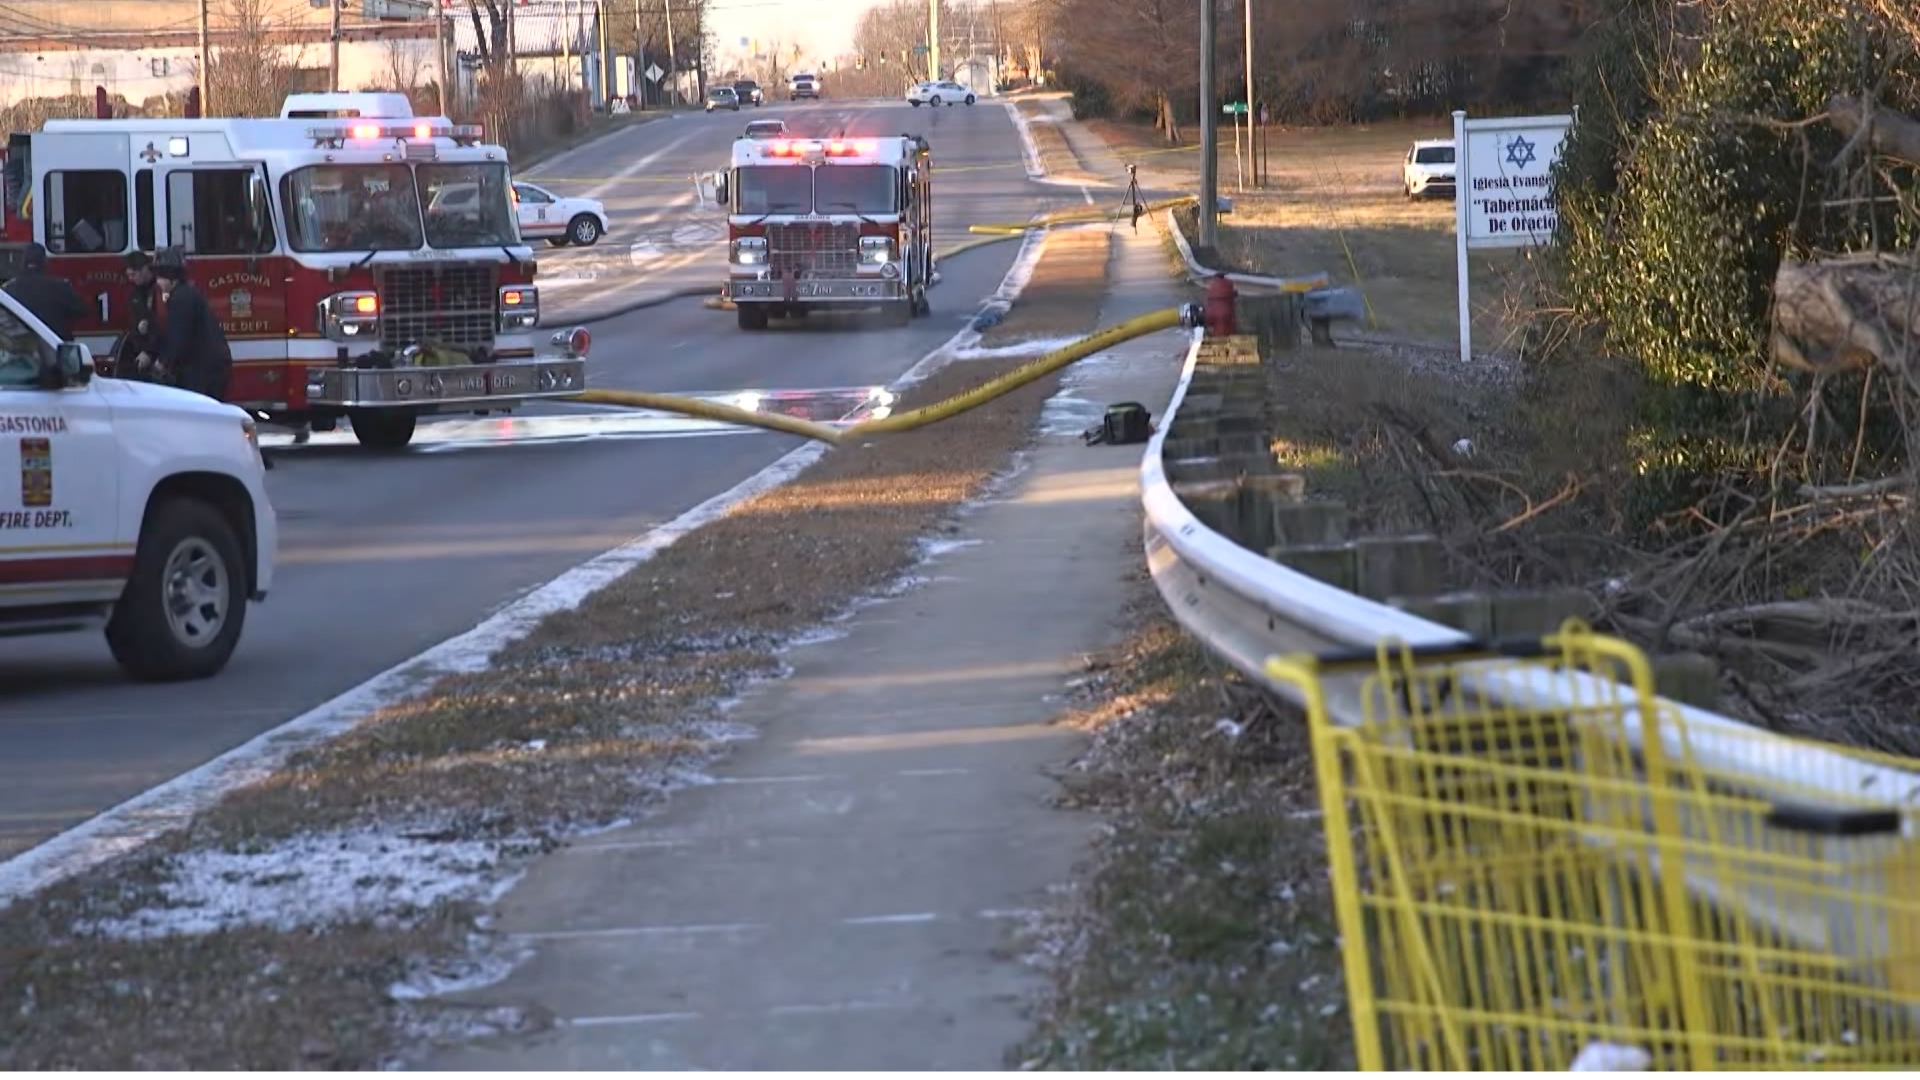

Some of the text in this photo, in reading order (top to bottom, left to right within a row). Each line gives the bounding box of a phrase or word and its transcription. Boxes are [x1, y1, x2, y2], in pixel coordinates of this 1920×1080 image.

[1473, 176, 1510, 191] Iglesia
[1489, 217, 1507, 234] De
[208, 272, 271, 289] GASTONIA
[97, 291, 110, 323] 1
[218, 320, 238, 332] IRE
[0, 416, 67, 433] GASTONIA
[0, 510, 72, 529] FIRE DEPT.
